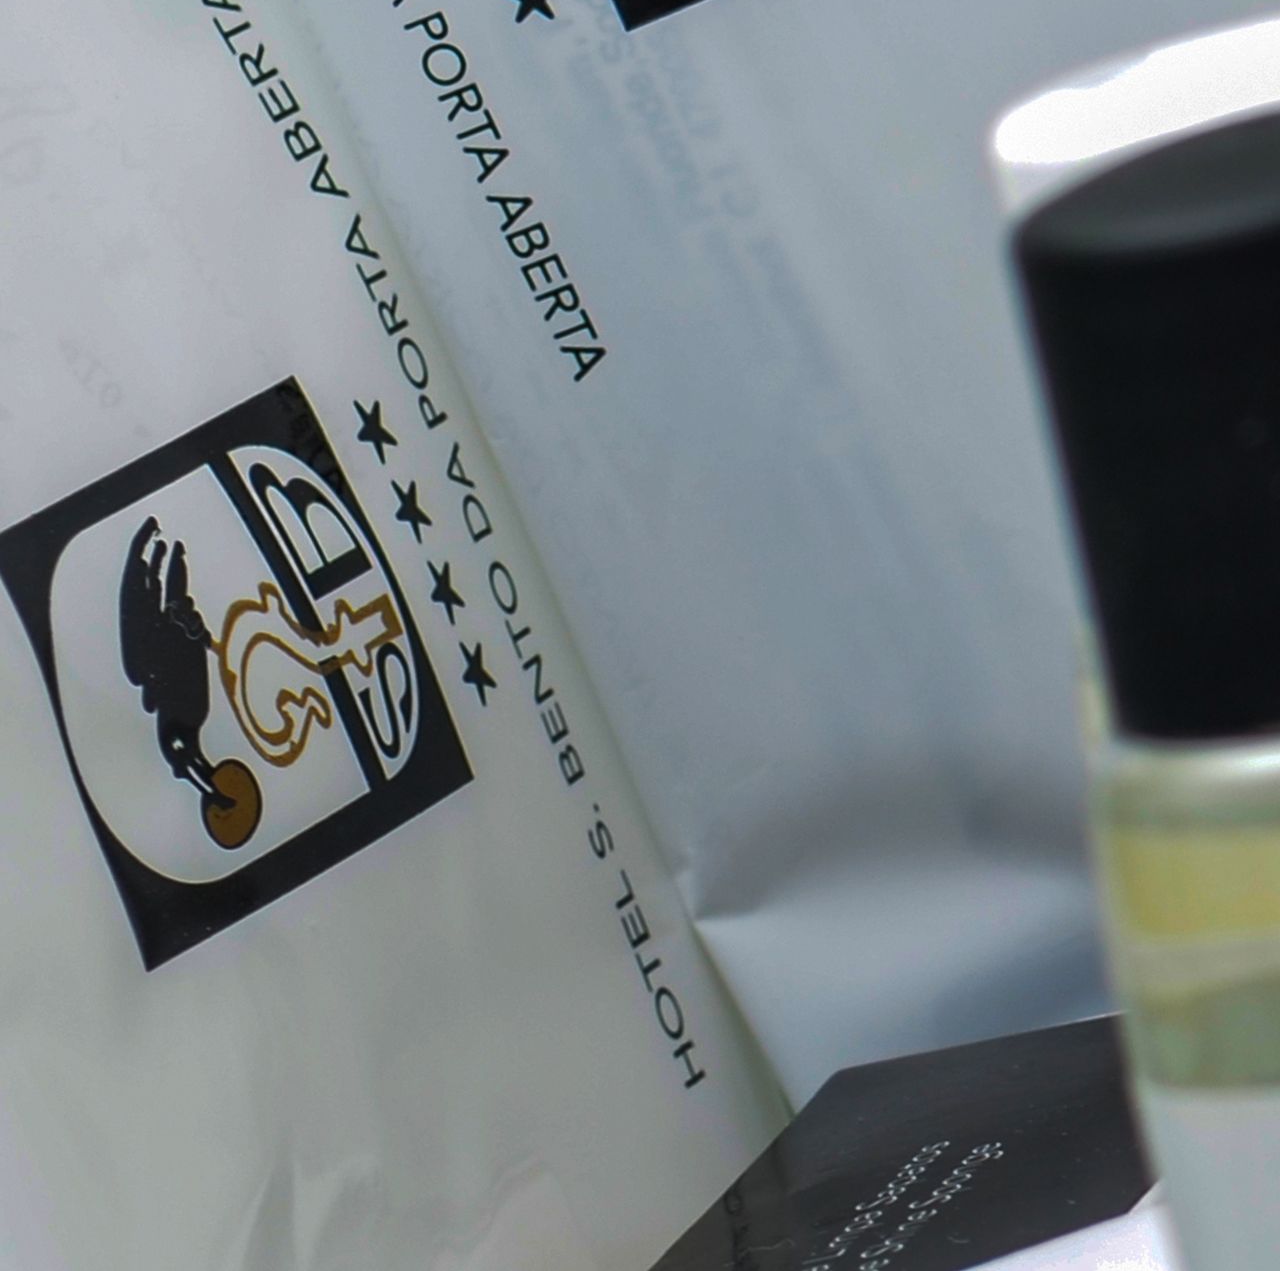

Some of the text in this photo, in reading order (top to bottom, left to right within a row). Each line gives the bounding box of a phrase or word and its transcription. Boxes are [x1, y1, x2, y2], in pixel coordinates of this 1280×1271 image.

[404, 11, 509, 184] PORTA
[486, 196, 606, 382] ABERTA
[345, 214, 448, 429] PORTA
[447, 442, 493, 543] DA
[489, 561, 585, 786] BENTO
[588, 804, 614, 859] S.
[615, 871, 706, 1089] HOTEL
